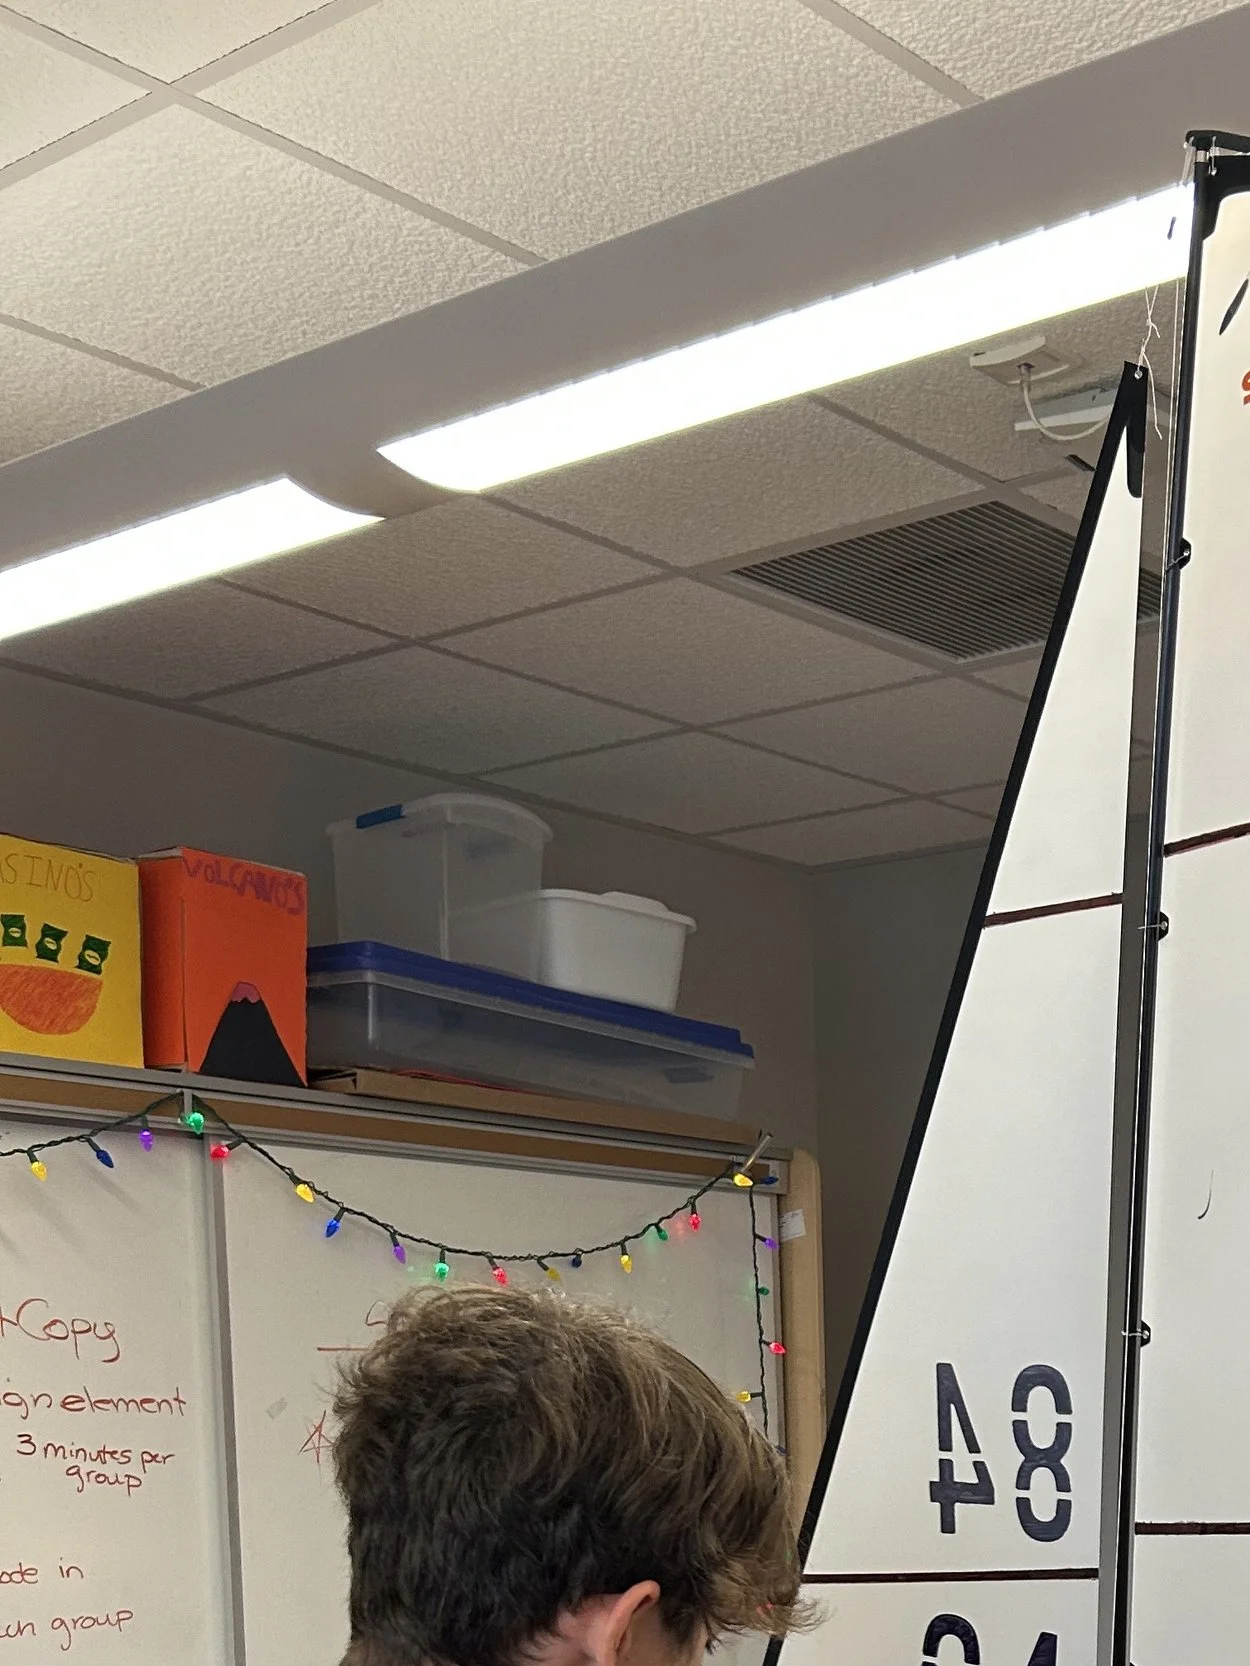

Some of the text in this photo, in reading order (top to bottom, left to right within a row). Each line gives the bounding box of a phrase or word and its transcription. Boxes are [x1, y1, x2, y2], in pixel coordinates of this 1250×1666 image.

[60, 1386, 187, 1416] element
[17, 1434, 175, 1473] 3 minutes per
[66, 1465, 142, 1497] group
[0, 1557, 84, 1584] ode in
[0, 1610, 134, 1651] ch group
